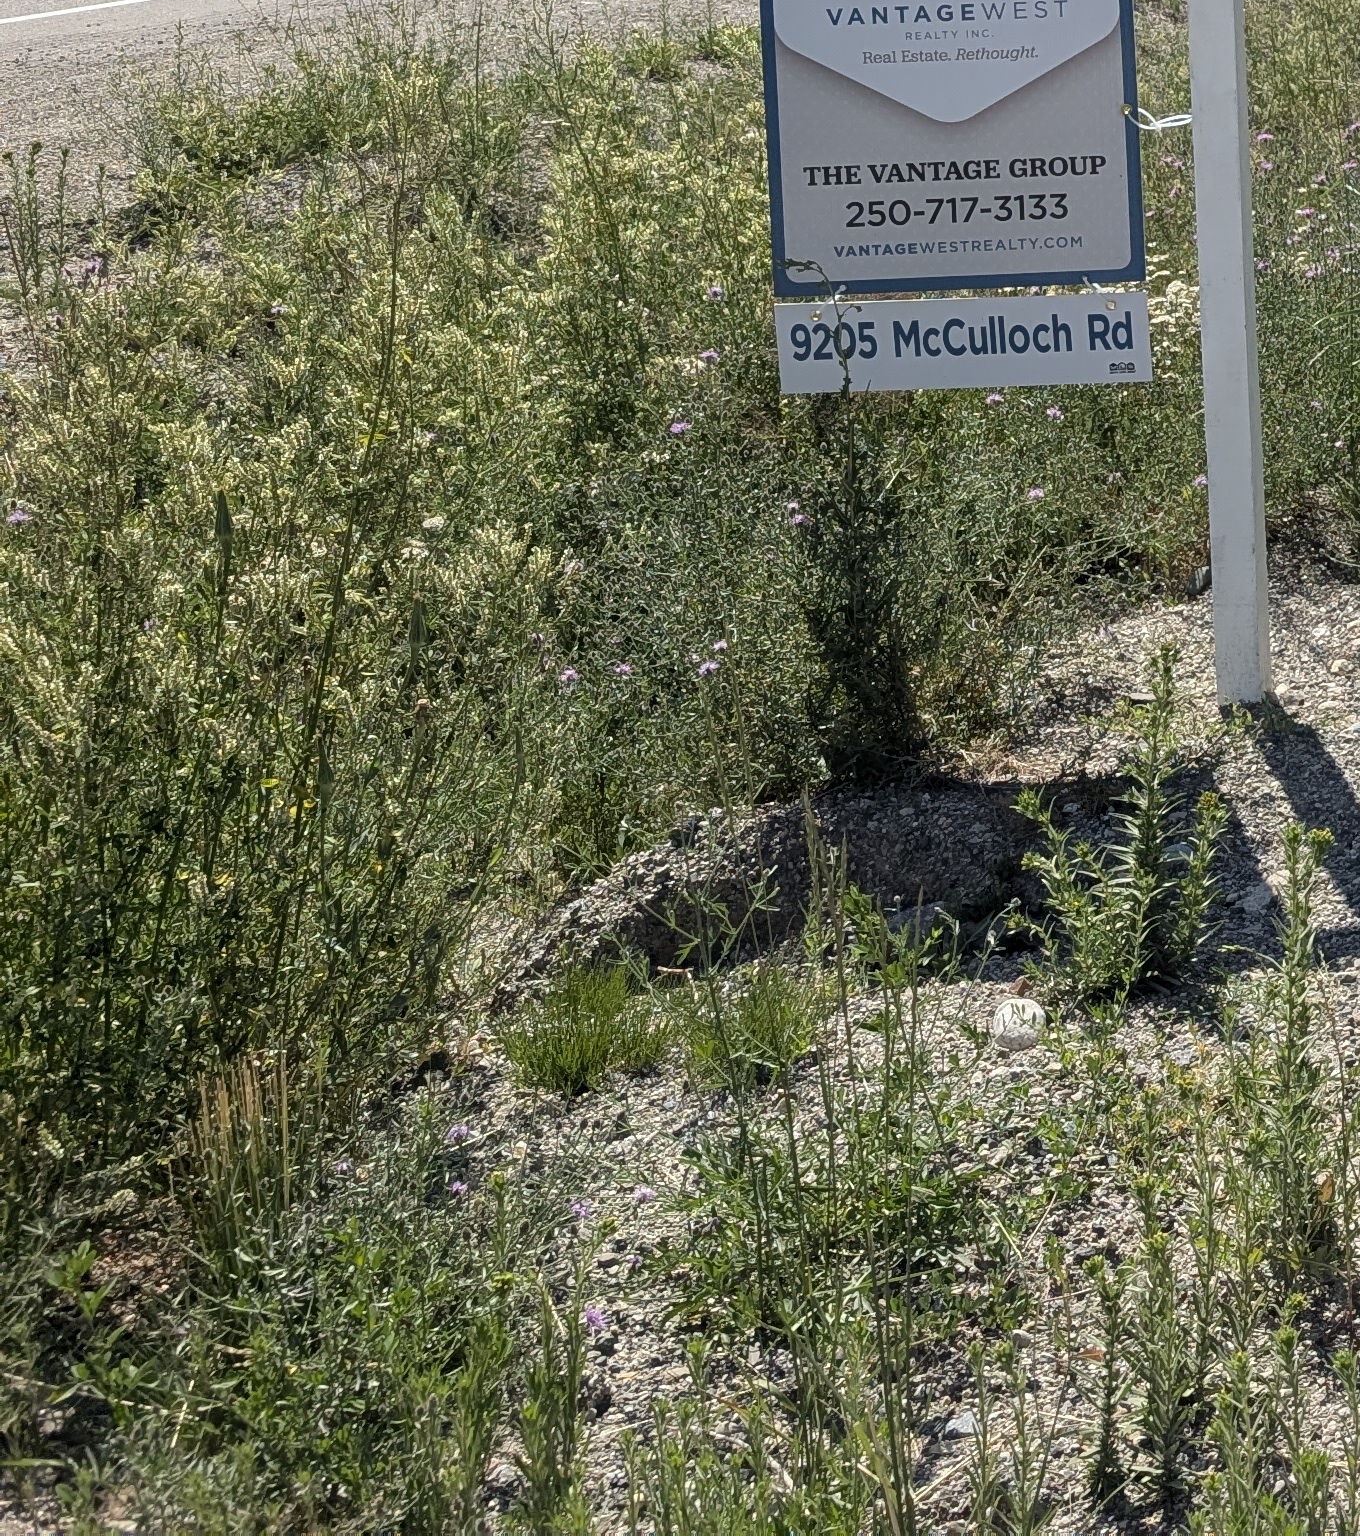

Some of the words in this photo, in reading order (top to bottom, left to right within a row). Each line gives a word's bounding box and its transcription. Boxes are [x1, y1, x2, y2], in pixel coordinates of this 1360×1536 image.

[826, 0, 1069, 26] VANTAGEWEST
[905, 29, 959, 41] REALTY
[966, 28, 995, 40] INC.
[862, 50, 898, 65] Real
[901, 46, 952, 63] Estate.
[955, 45, 1040, 63] Rethought.
[803, 164, 862, 186] THE
[867, 159, 1001, 184] VANTAGE
[1008, 154, 1107, 179] GROUP
[845, 192, 1070, 228] 250-717-3133
[833, 235, 1084, 258] VANTAGEWESTREALTY.COM
[790, 321, 878, 362] 9205
[892, 313, 1073, 358] McCulloch
[1087, 311, 1134, 352] Rd
